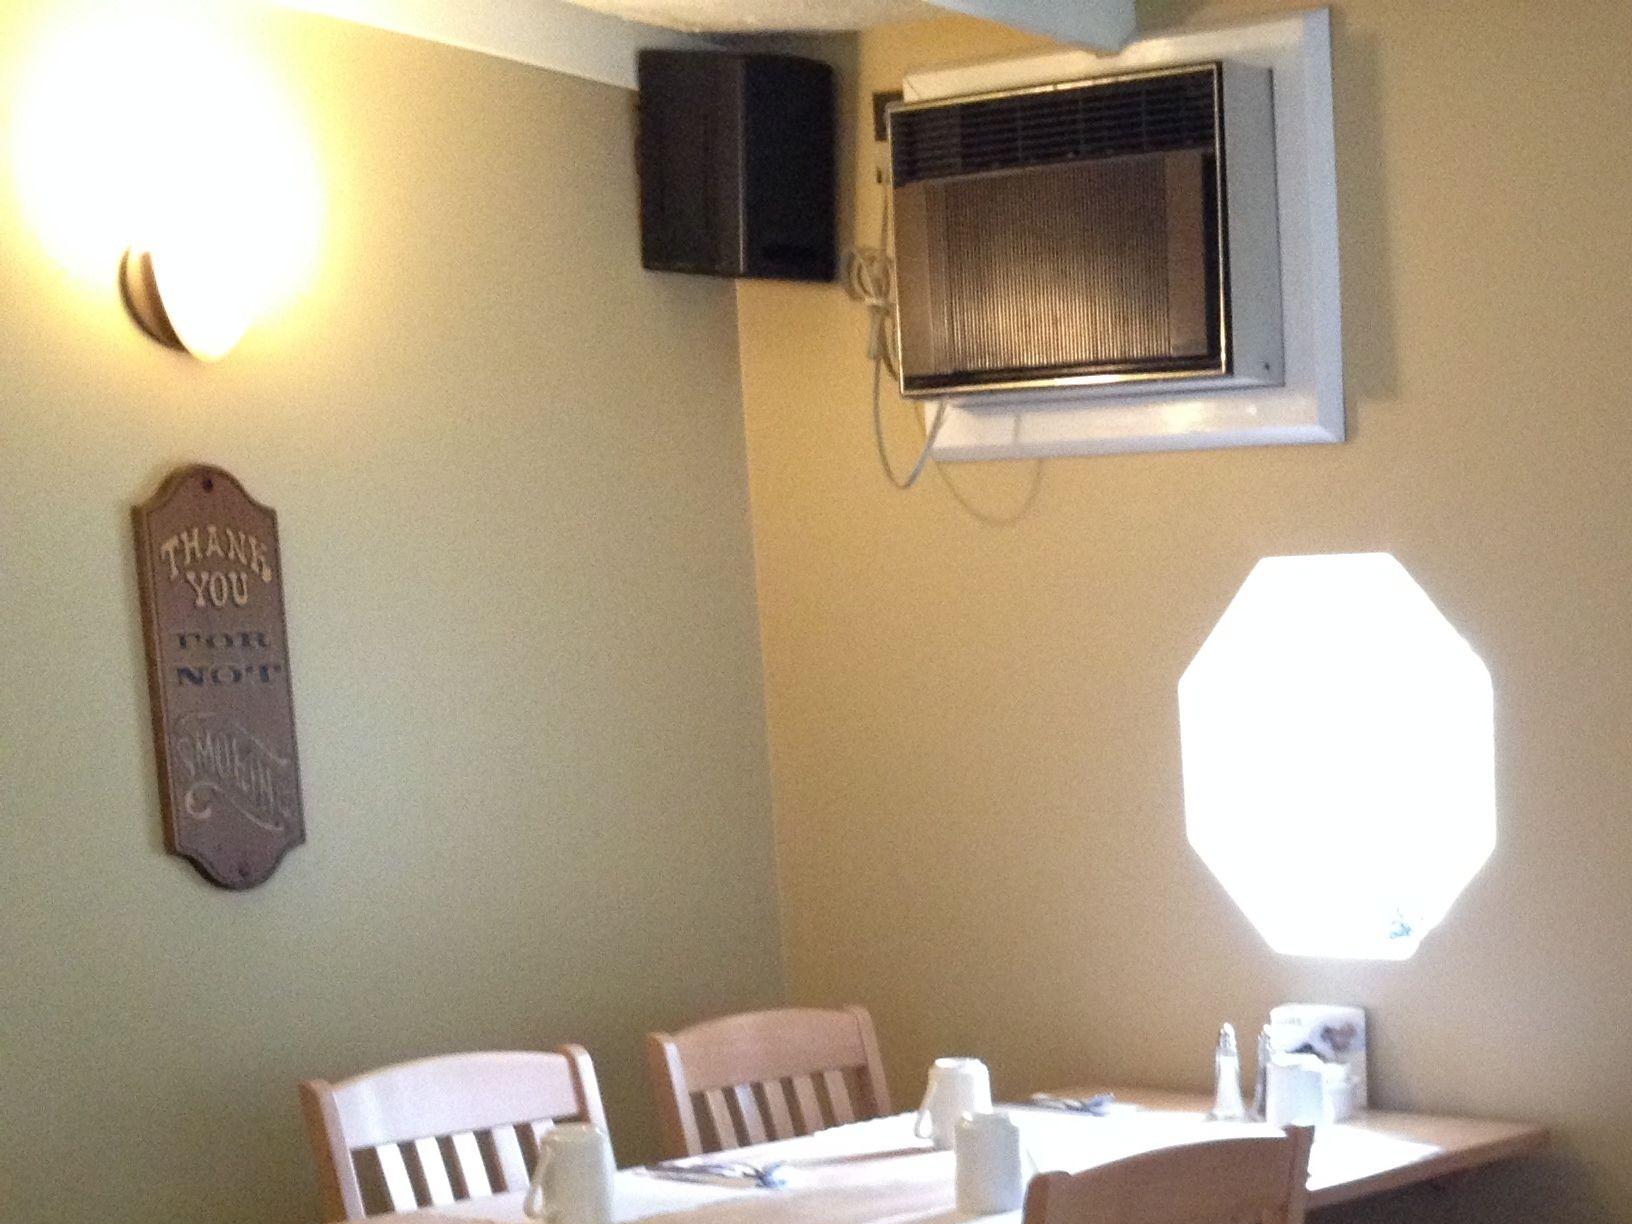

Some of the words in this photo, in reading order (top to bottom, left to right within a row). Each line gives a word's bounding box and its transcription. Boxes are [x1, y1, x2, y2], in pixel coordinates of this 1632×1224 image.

[160, 525, 273, 583] THANK
[186, 571, 249, 608] YOU
[176, 631, 271, 650] FOR
[176, 663, 283, 687] NOT
